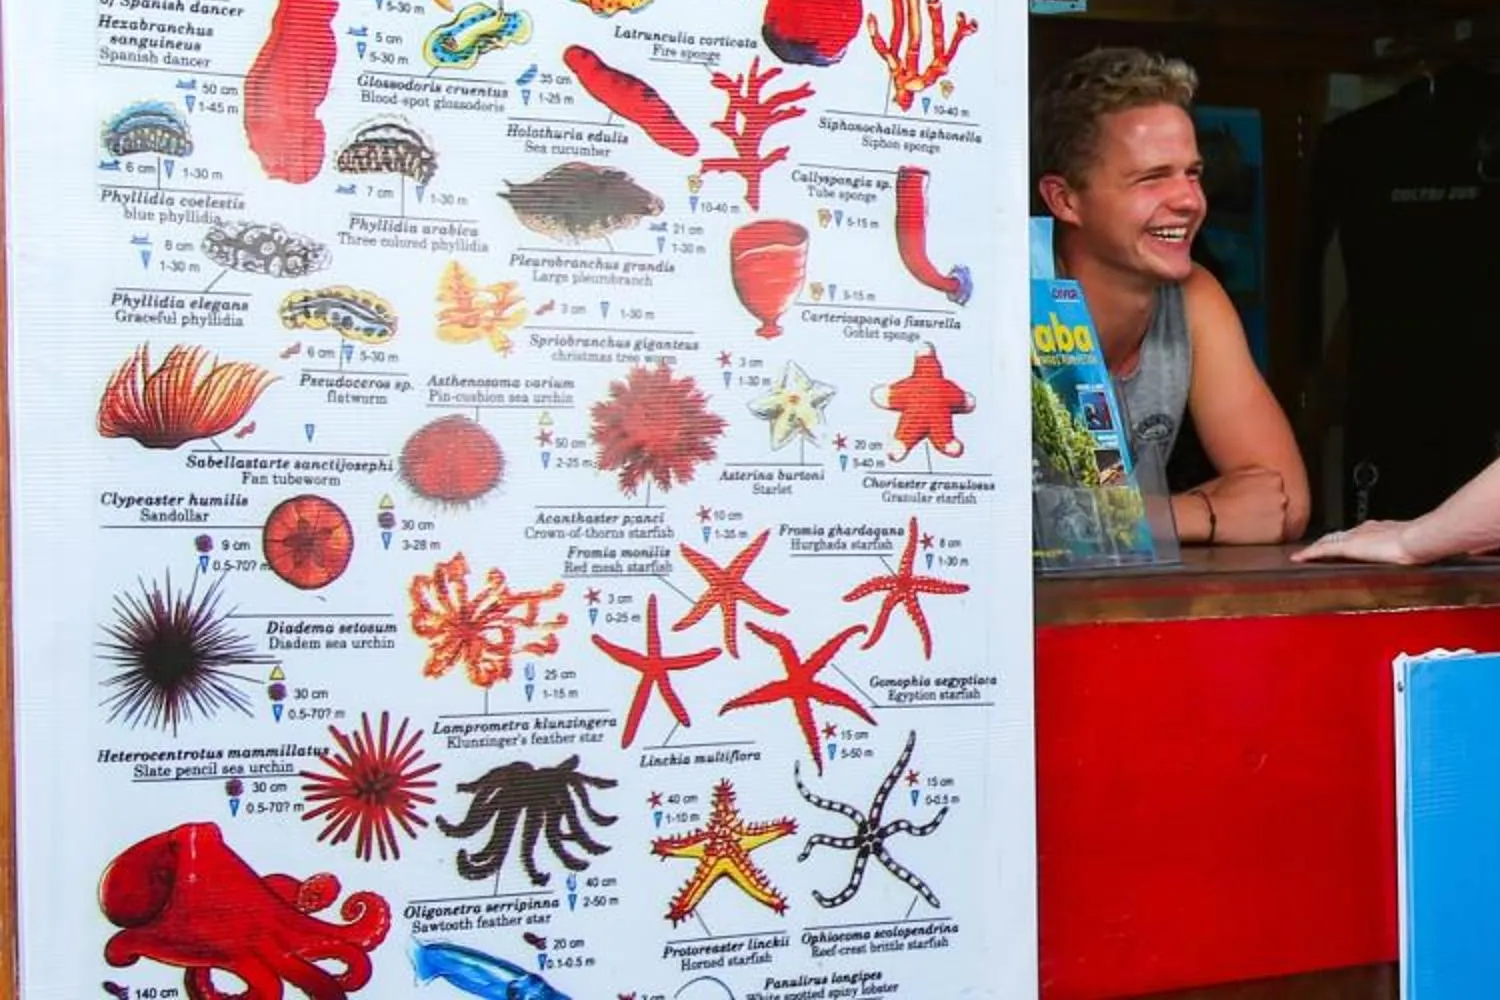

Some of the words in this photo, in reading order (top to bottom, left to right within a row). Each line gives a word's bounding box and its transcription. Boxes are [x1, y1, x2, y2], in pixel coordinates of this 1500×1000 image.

[189, 0, 244, 17] dancer
[98, 14, 214, 37] Hexabranchus
[109, 34, 201, 53] sanguineus
[614, 25, 697, 46] Latrunculia
[701, 35, 758, 50] corticata
[100, 46, 159, 65] Spanish
[163, 51, 211, 69] dancer
[369, 51, 395, 64] 5-30
[652, 44, 677, 59] Fire
[680, 46, 721, 62] sponge
[445, 81, 509, 99] cruentus
[506, 124, 583, 143] Holothuria
[587, 130, 629, 145] edulis
[525, 141, 548, 154] Sea
[551, 144, 611, 158] cucumber
[861, 136, 900, 151] Siphon
[903, 141, 941, 155] sponge
[183, 167, 208, 180] 1-30
[100, 189, 175, 207] Phyllidia
[179, 196, 245, 211] coelestis
[807, 185, 835, 198] Tube
[838, 189, 877, 202] sponge
[124, 206, 155, 220] blue
[159, 211, 221, 225] phyllidia
[350, 217, 417, 235] Phyllidia
[421, 223, 479, 238] arabica
[509, 253, 620, 273] Pleurobranchus
[623, 258, 675, 275] grandis
[111, 291, 184, 310] Phyllidia
[187, 299, 249, 314] elegans
[114, 309, 176, 326] Graceful
[180, 313, 244, 328] phyllidia
[633, 338, 699, 353] giganteus
[299, 374, 390, 390] Pseudoceros
[426, 375, 521, 391] Asthenosoma
[525, 377, 575, 390] varium
[428, 389, 504, 404] Pin-cushion
[533, 391, 571, 405] urchin
[185, 455, 291, 471] Sabellastarte
[241, 472, 268, 485] Fan
[272, 474, 341, 487] tubeworm
[752, 483, 792, 495] Starlet
[100, 491, 183, 509] Clypeaster
[188, 493, 249, 507] humilis
[140, 508, 210, 523] Sandollar
[627, 525, 675, 540] starfish
[567, 546, 617, 559] Fromia
[627, 559, 673, 574] starfish
[266, 621, 335, 635] Diadema
[337, 623, 397, 635] setosum
[268, 637, 321, 650] Diadem
[325, 638, 347, 649] sea
[352, 636, 395, 649] urchin
[432, 721, 531, 737] Lamprometra
[530, 733, 575, 746] feather
[579, 731, 605, 744] star
[97, 748, 224, 766] Heterocentrotus
[694, 750, 762, 765] multiflora
[133, 764, 172, 778] Slate
[176, 763, 217, 778] pencil
[221, 764, 245, 775] sea
[249, 761, 295, 774] urchin
[485, 898, 560, 915] serripinna
[411, 918, 474, 934] Sawtooth
[477, 914, 522, 929] feather
[526, 912, 552, 925] star
[680, 957, 725, 972] Horned
[727, 952, 773, 968] starfish
